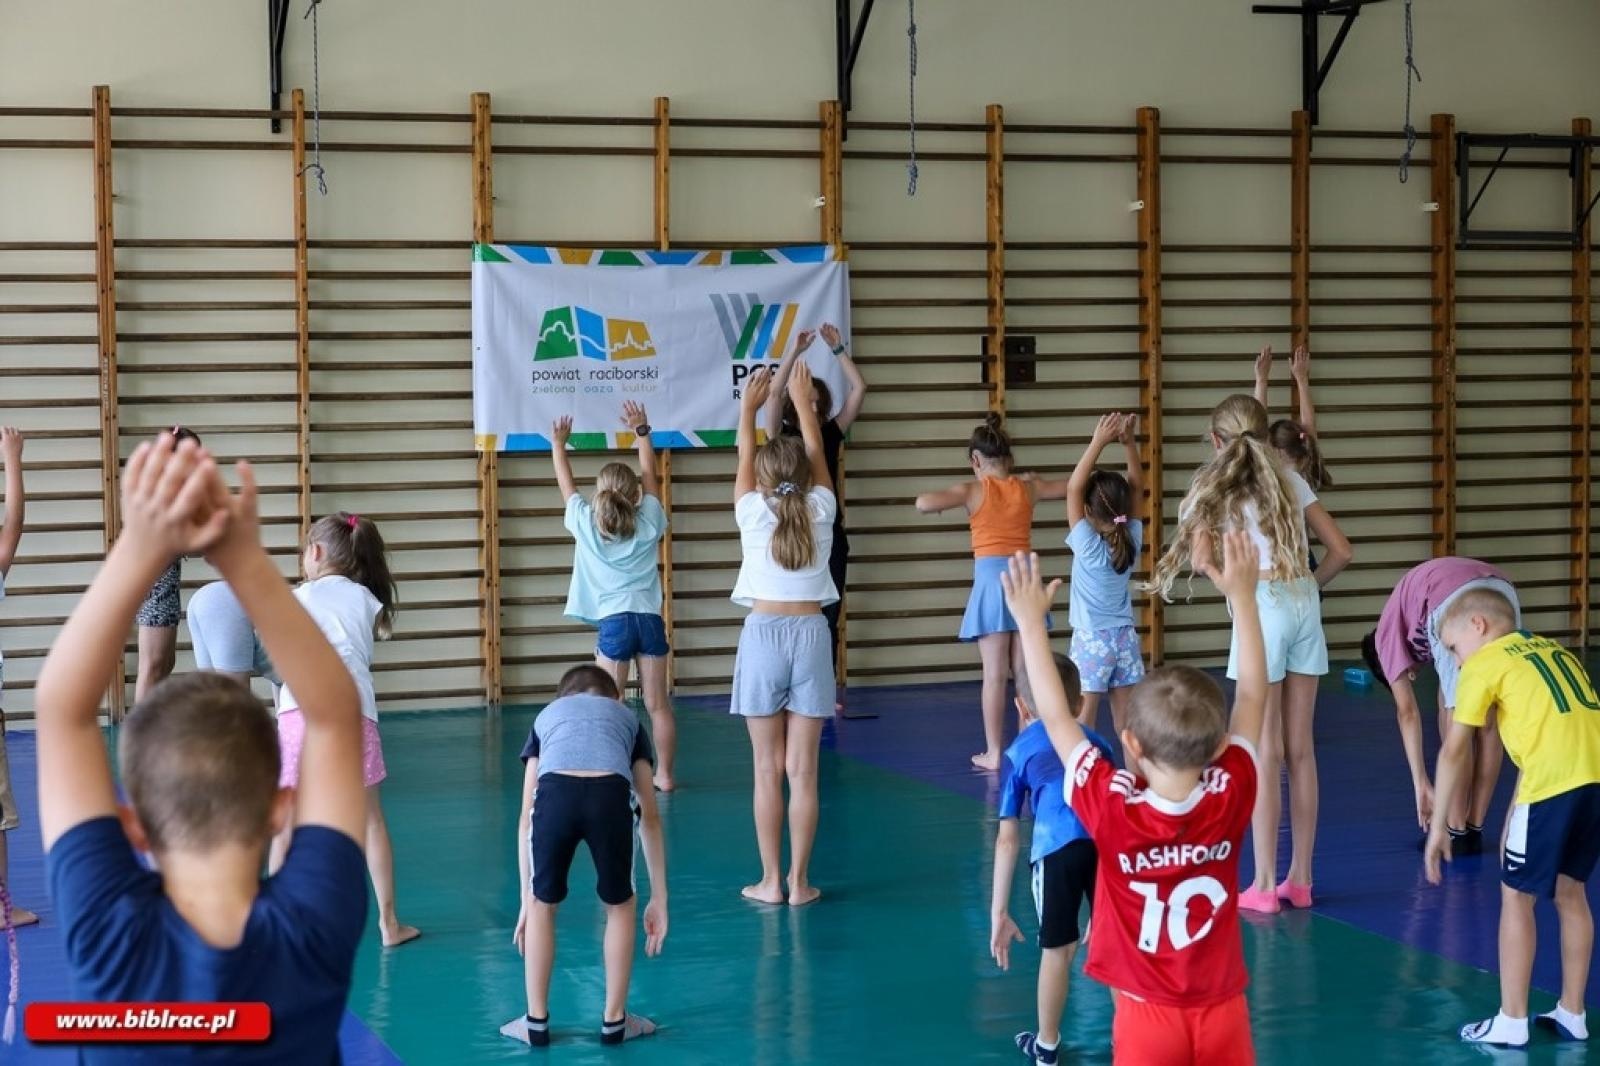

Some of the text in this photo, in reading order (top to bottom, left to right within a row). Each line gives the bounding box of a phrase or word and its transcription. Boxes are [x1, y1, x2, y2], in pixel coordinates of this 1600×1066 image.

[532, 366, 659, 384] powiat raciborski
[584, 385, 614, 393] oaza
[622, 383, 657, 393] kultur
[1523, 650, 1600, 714] 10
[1128, 875, 1229, 954] 10
